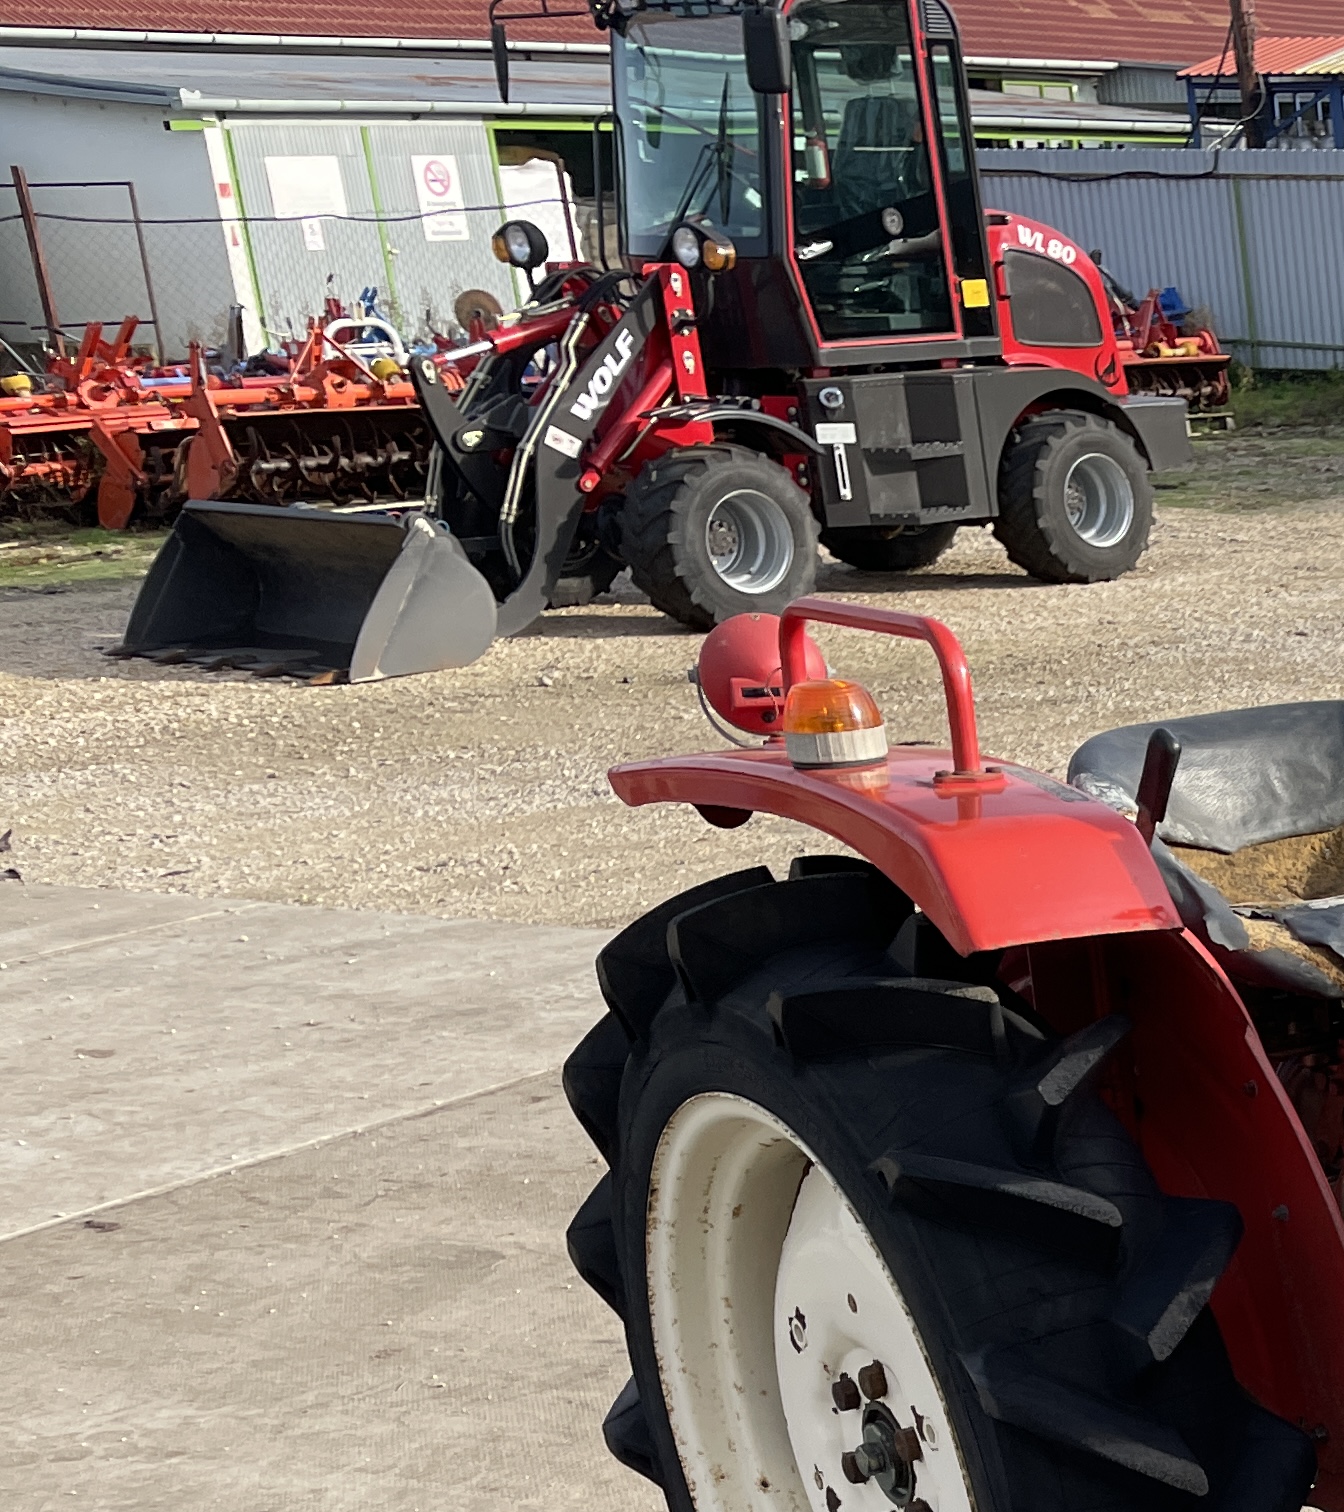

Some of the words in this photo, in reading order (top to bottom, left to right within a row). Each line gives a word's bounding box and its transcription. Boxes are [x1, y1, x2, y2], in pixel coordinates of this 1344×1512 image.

[1017, 224, 1045, 253] WL
[1047, 239, 1077, 265] 80
[570, 328, 634, 421] WOLF
